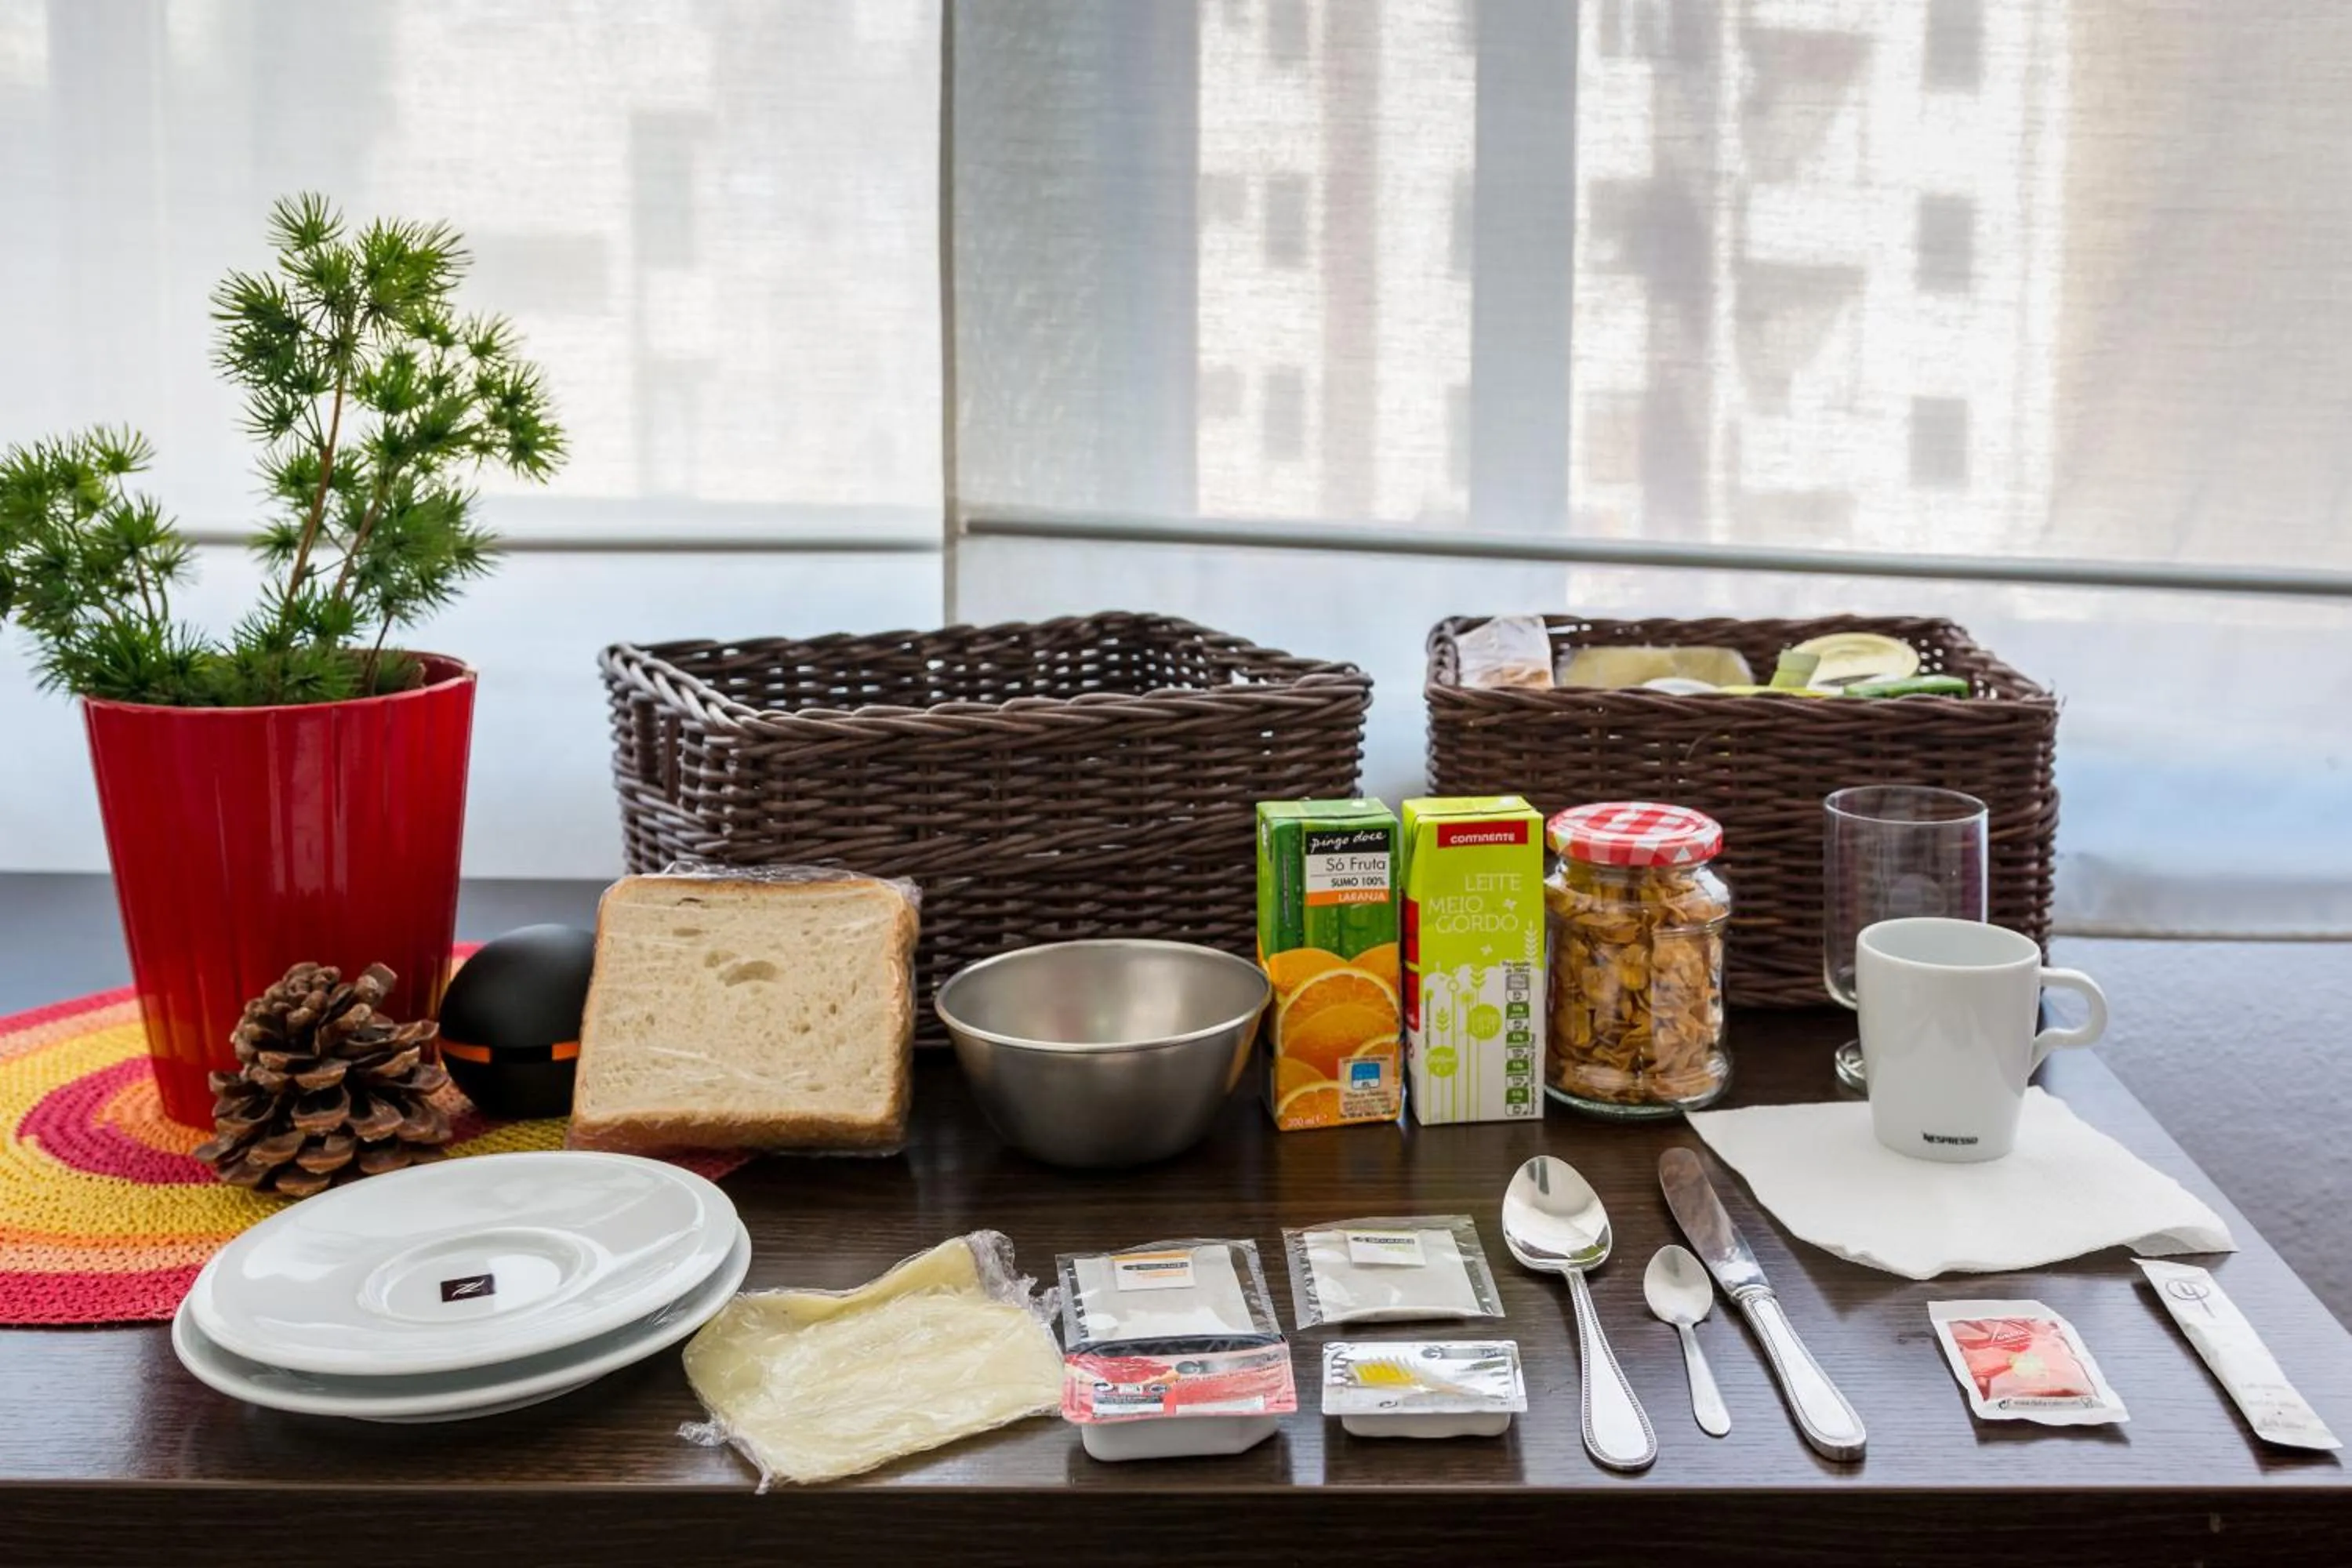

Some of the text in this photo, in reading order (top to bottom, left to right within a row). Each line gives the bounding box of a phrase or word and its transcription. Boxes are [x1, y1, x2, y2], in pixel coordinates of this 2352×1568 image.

[1309, 830, 1387, 854] pingo doce
[1325, 857, 1387, 872] Só Fruta
[1330, 876, 1386, 887] SUMO 100%
[1465, 873, 1523, 892] LEITE
[1338, 891, 1387, 902] LARANJA
[1427, 895, 1484, 916] MEIO
[1435, 913, 1519, 934] GORDO
